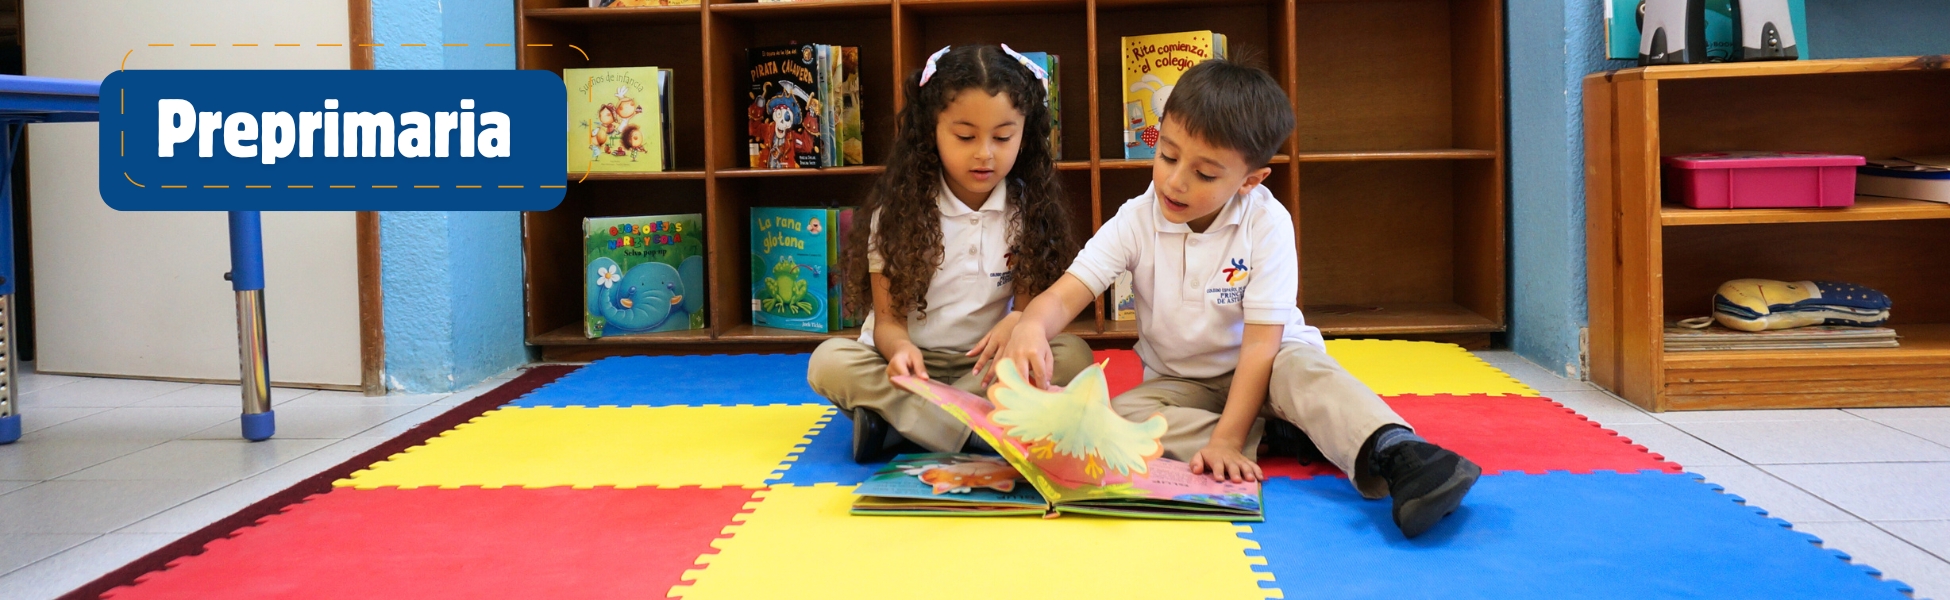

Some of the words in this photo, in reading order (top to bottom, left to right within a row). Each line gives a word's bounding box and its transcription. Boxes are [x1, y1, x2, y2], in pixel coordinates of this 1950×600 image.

[1132, 44, 1156, 61] Rita
[1157, 41, 1204, 57] comienza
[751, 61, 778, 82] PIRATA
[782, 59, 813, 84] CALAVERA
[1141, 58, 1151, 74] el
[1155, 52, 1194, 71] colegio
[605, 71, 615, 83] de
[616, 71, 644, 92] infancia
[609, 223, 641, 236] OJOS,
[642, 220, 682, 235] OREJAS
[758, 217, 772, 232] La
[776, 216, 802, 232] rana
[607, 235, 641, 250] NARIZ
[643, 236, 651, 247] Y
[653, 233, 682, 246] COLA
[763, 231, 805, 254] glotona
[623, 248, 642, 257] Selva
